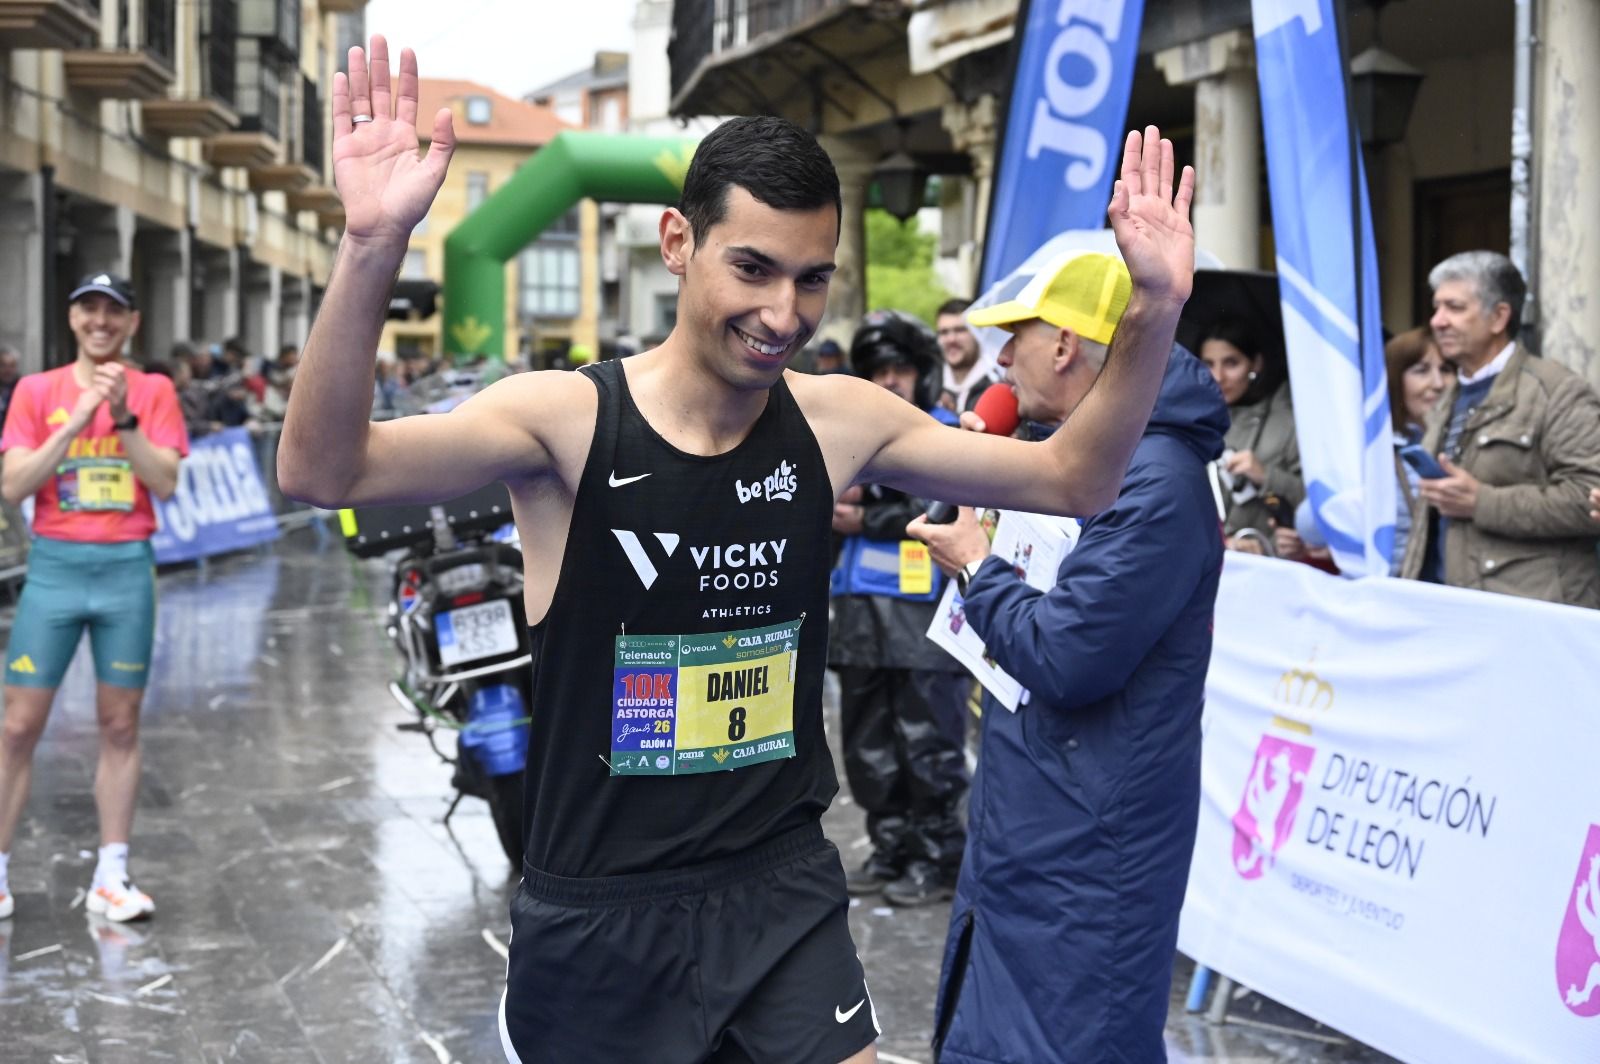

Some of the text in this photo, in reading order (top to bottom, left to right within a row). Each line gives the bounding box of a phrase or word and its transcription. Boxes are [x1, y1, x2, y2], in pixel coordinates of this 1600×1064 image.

[736, 460, 798, 504] be plus
[689, 538, 788, 570] VICKY
[699, 570, 779, 592] FOODS
[702, 604, 772, 619] ATHLETICS
[738, 628, 794, 648] CAJA RURAL
[619, 650, 672, 661] Telenauto
[691, 645, 717, 653] VEOLIA
[620, 673, 672, 700] 10K
[707, 665, 769, 703] DANIEL
[617, 697, 674, 707] CIUDAD DE
[616, 708, 675, 719] ASTORGA
[727, 706, 747, 741] 8
[653, 720, 671, 733] 26
[640, 738, 673, 749] CAJÓN A
[732, 738, 790, 759] CAJA RURAL
[1321, 753, 1497, 839] DIPUTACIÓN
[1306, 806, 1425, 880] DE LEÓN
